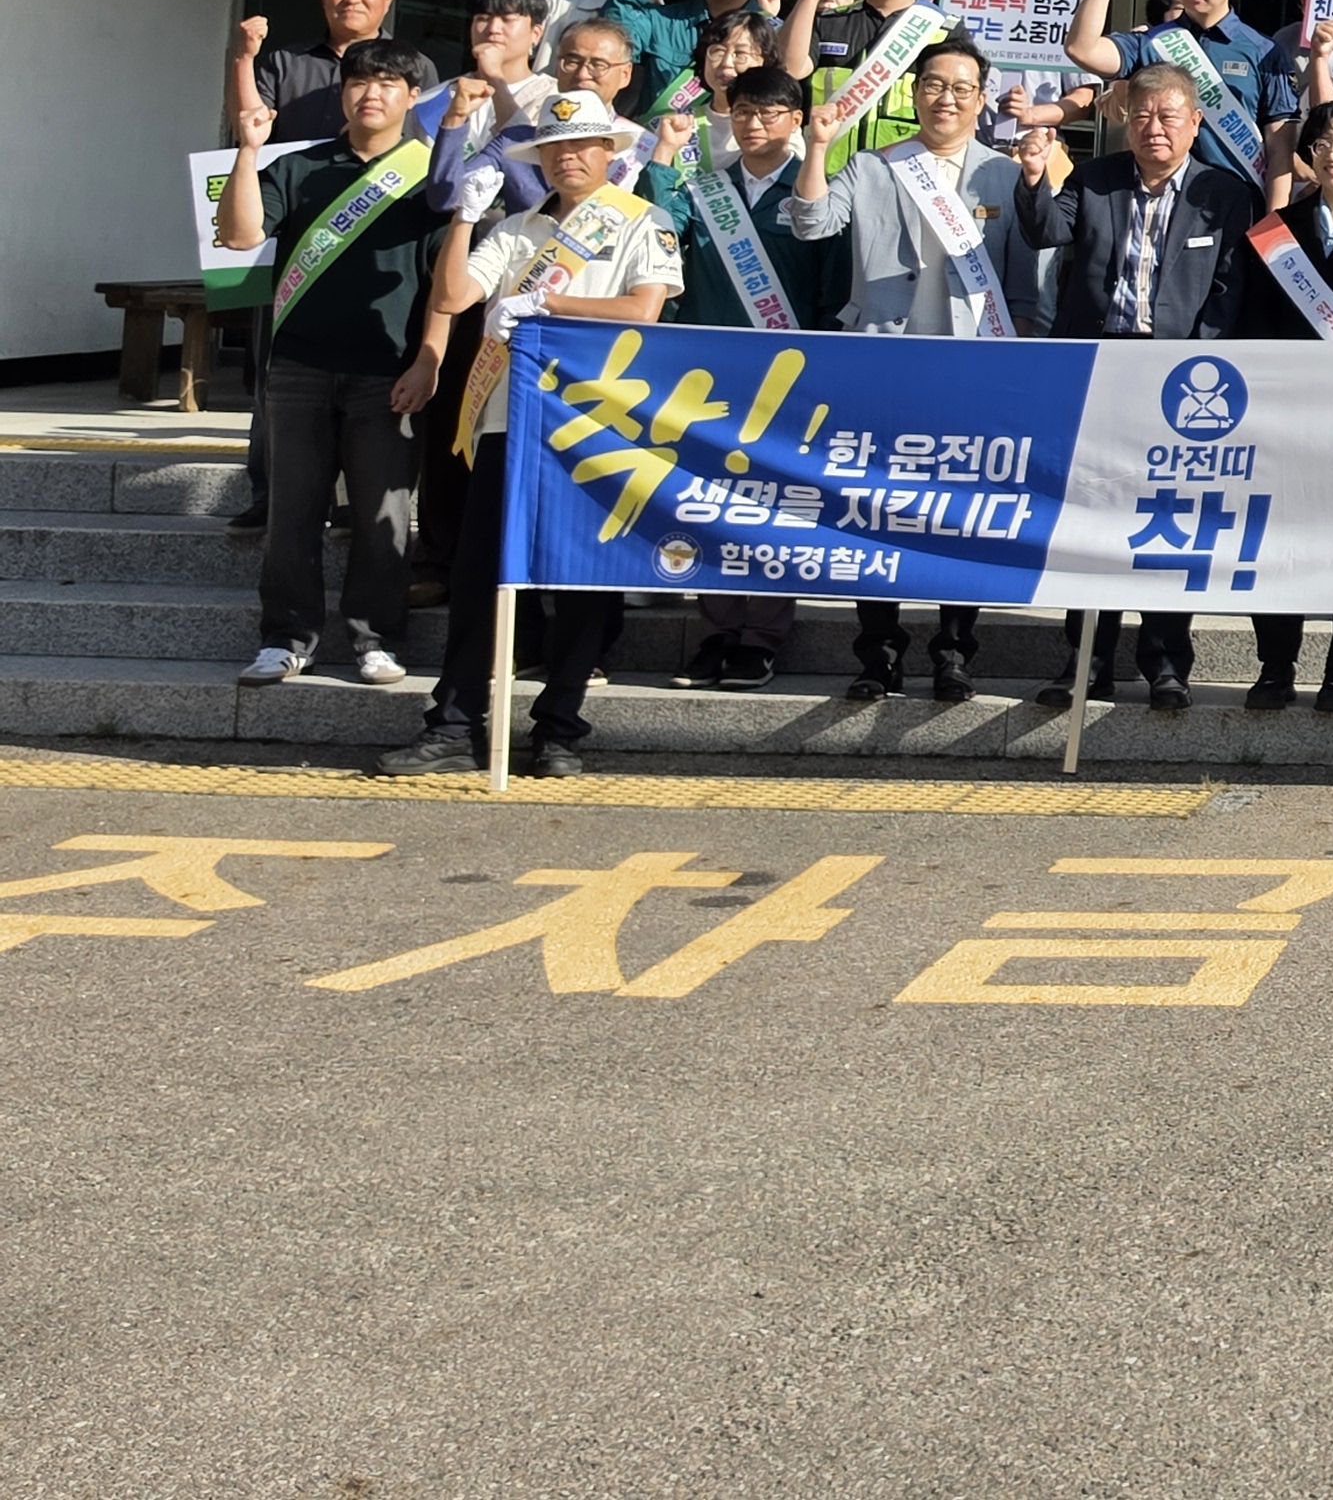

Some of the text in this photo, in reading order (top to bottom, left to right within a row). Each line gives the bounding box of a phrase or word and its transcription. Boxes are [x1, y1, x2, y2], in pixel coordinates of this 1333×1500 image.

[960, 16, 1004, 42] 구는
[1217, 109, 1260, 161] 행복한
[331, 170, 404, 235] 안전문화
[300, 229, 338, 269] 확산
[727, 237, 773, 297] 행복한
[823, 430, 875, 479] 한
[888, 432, 1033, 484] 운전이
[1145, 443, 1256, 483] 안전띠
[675, 475, 1032, 540] 생명을 지킵니다
[719, 542, 901, 583] 함양경찰서
[1127, 488, 1272, 593] 착!
